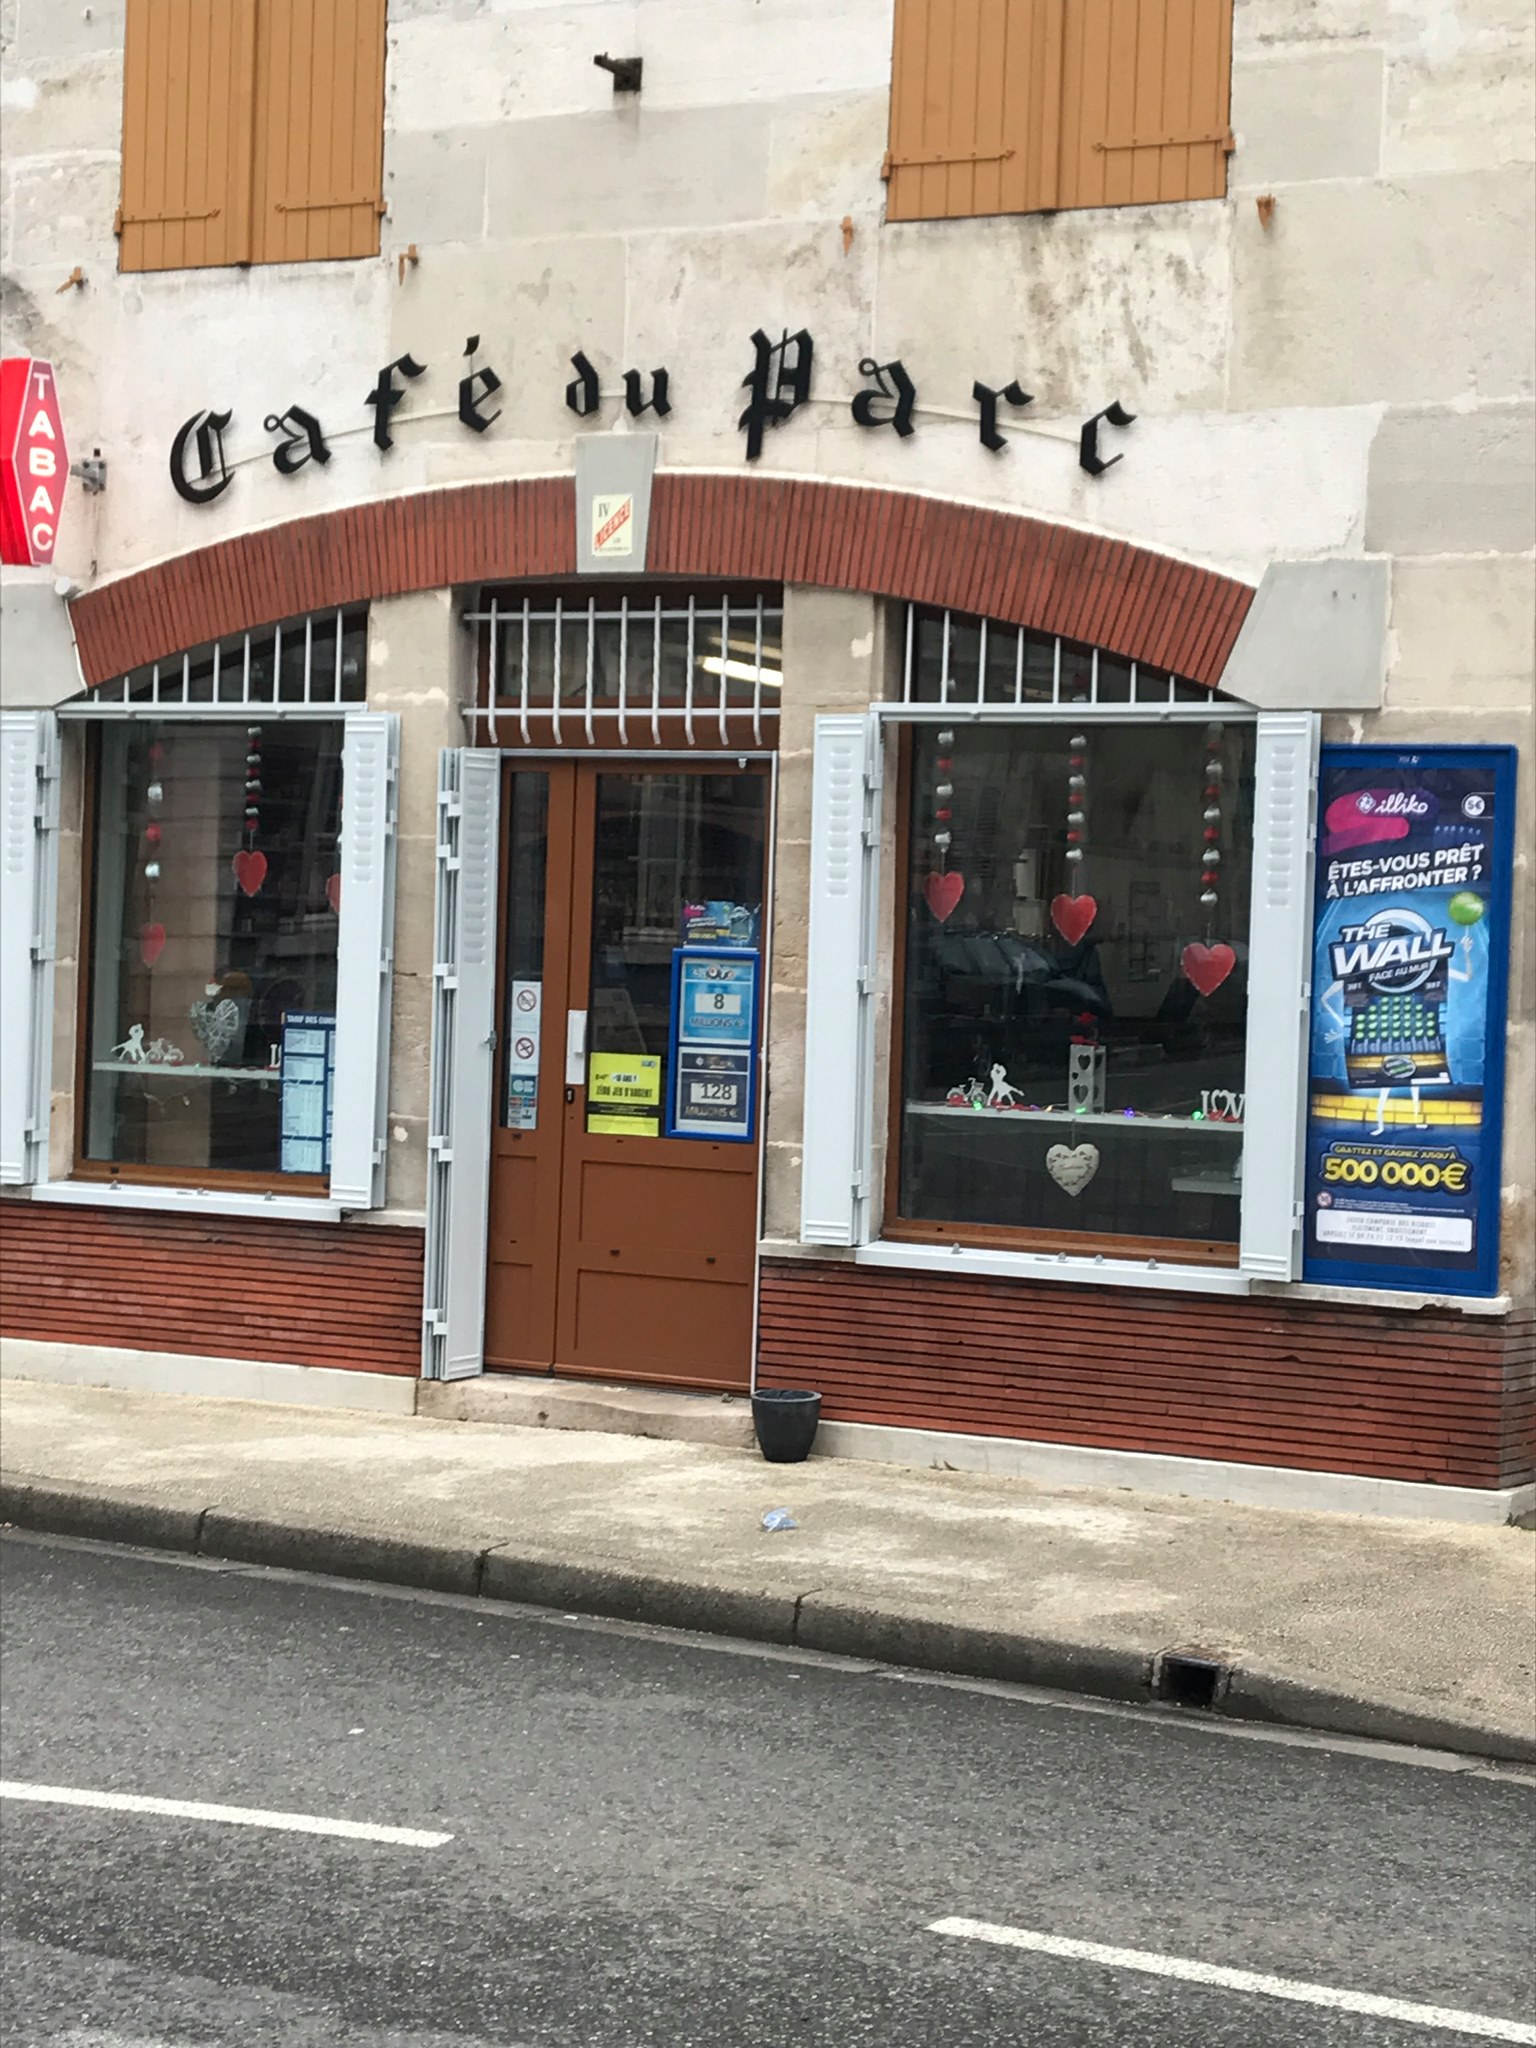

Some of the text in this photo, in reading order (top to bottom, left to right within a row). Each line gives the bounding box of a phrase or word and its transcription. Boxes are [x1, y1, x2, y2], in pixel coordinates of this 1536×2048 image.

[169, 327, 1138, 504] Café du Parc
[28, 372, 57, 551] TABAC
[1375, 792, 1429, 814] illiko
[1328, 843, 1485, 881] ÊTES-VOUS PRÊT
[1326, 865, 1483, 899] À L'AFFRONTER ?
[1342, 924, 1391, 942] THE
[1333, 933, 1452, 976] WALL
[1368, 969, 1394, 982] FACE
[1395, 967, 1408, 977] AU
[713, 993, 725, 1009] 8
[701, 1083, 732, 1100] 128
[1324, 1157, 1378, 1183] 500
